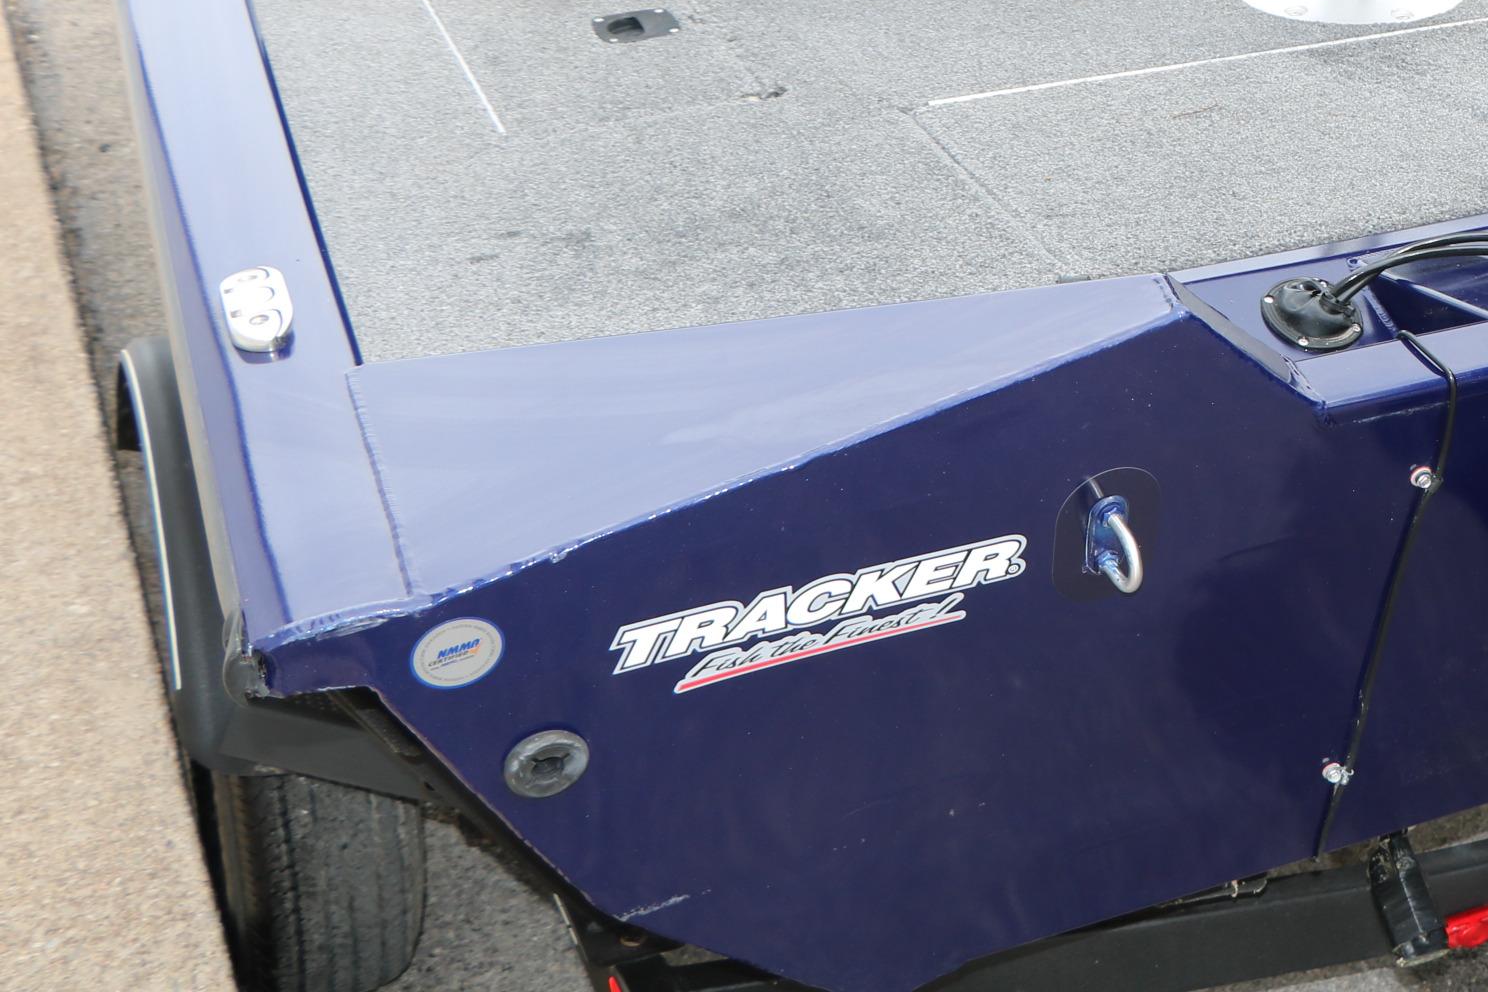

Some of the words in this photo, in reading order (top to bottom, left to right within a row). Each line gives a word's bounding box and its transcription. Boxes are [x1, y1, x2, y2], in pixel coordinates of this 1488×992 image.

[611, 535, 1026, 674] TRACKER
[691, 645, 762, 678] Fish
[770, 634, 819, 658] the
